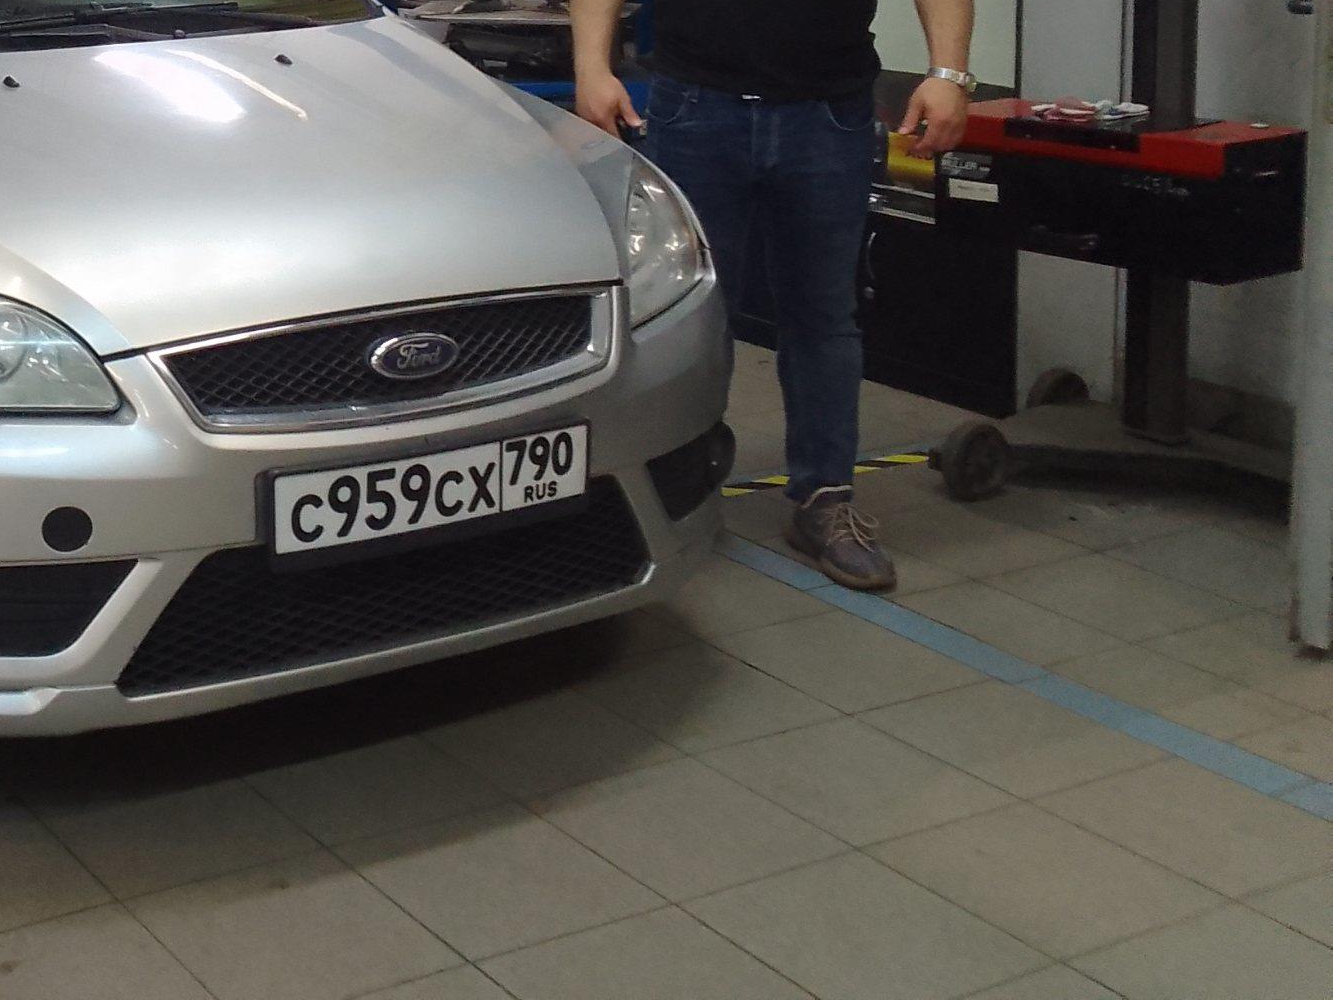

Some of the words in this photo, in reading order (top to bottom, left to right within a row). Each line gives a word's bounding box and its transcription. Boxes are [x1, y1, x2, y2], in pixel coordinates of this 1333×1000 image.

[396, 341, 443, 370] Ford
[291, 462, 497, 543] С959СХ
[505, 431, 574, 486] 790
[523, 480, 558, 504] RUS
